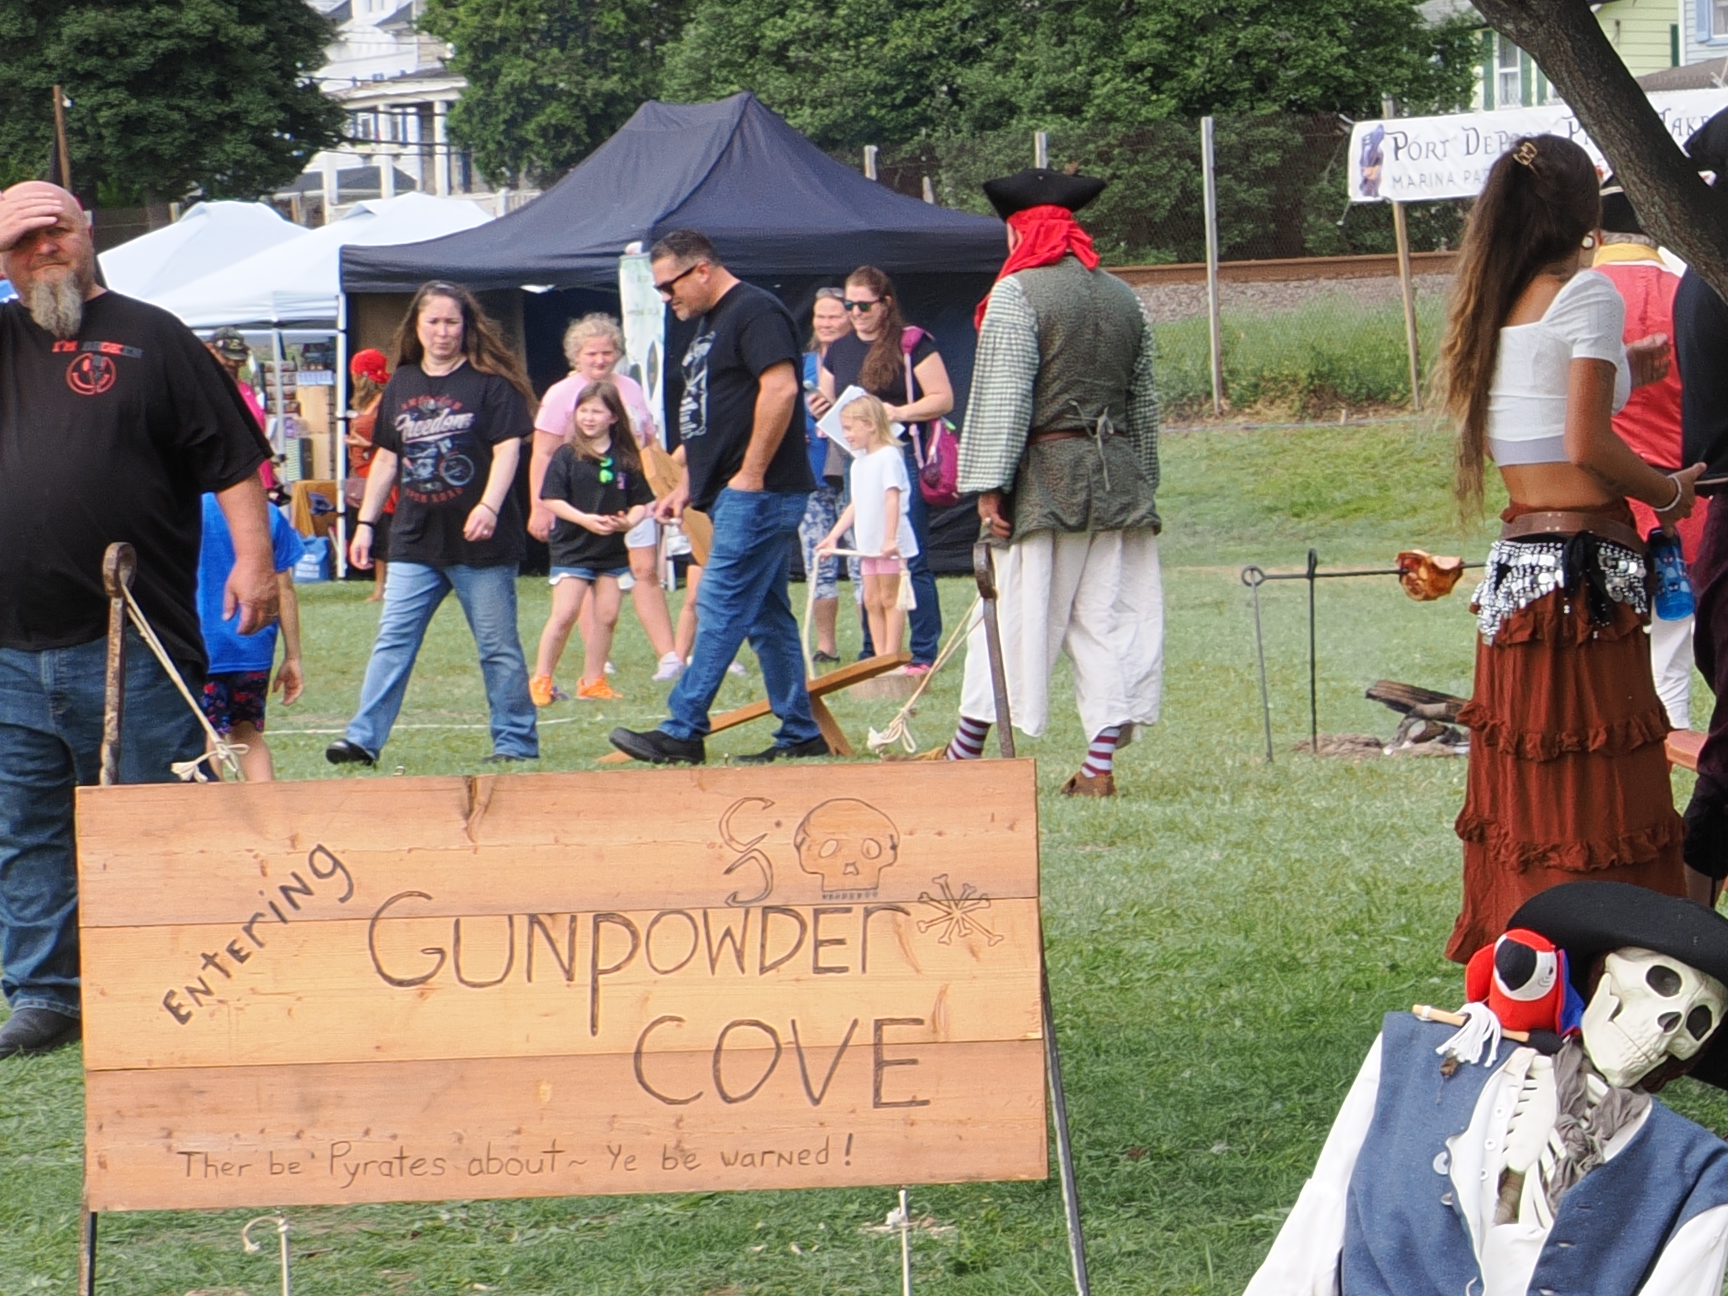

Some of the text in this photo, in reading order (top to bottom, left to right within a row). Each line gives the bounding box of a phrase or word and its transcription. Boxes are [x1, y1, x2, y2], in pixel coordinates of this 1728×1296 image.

[1392, 168, 1492, 190] MARINA PAR
[394, 407, 475, 443] Freedom
[633, 1014, 931, 1109] COVE
[176, 1150, 252, 1179] Ther
[329, 1140, 447, 1189] Pyrates
[605, 1144, 639, 1172] Ye
[661, 1144, 702, 1172] be
